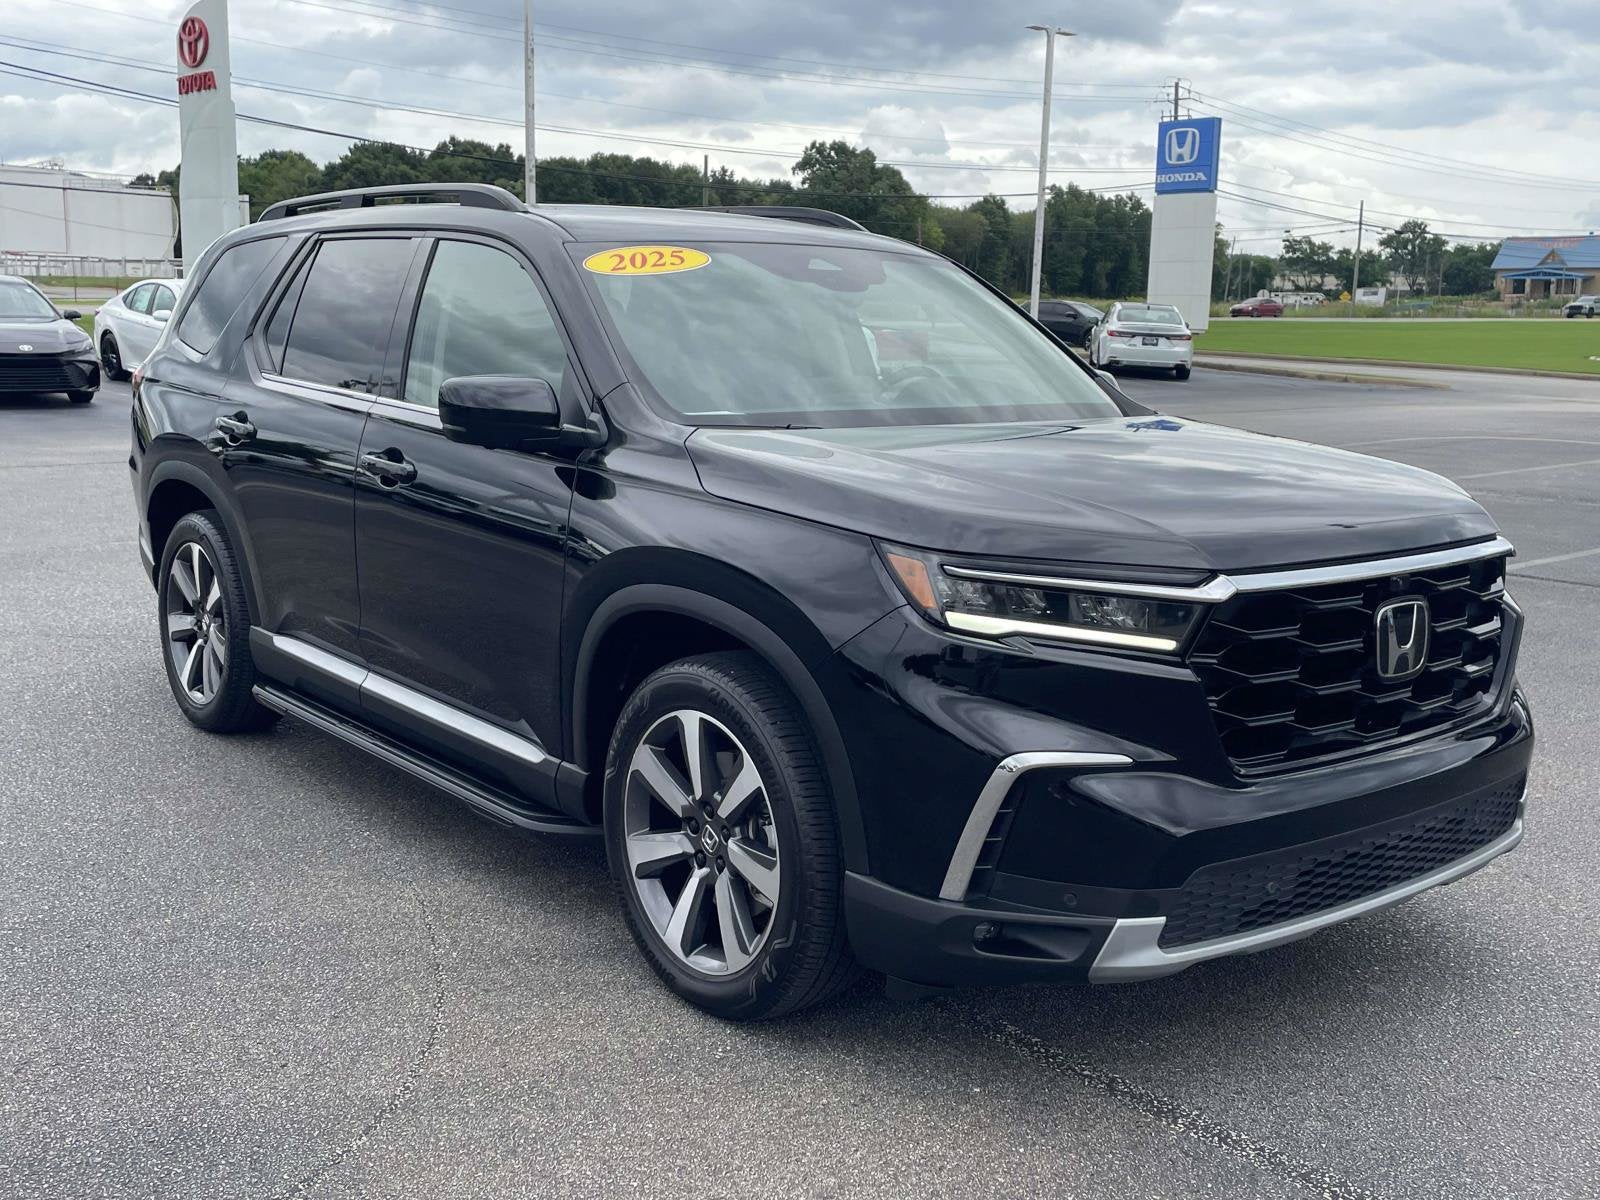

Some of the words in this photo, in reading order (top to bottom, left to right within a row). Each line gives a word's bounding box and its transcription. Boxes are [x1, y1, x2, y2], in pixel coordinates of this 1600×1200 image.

[177, 70, 217, 95] TOYOTA
[1157, 171, 1208, 183] HONDA
[609, 250, 686, 271] 2025
